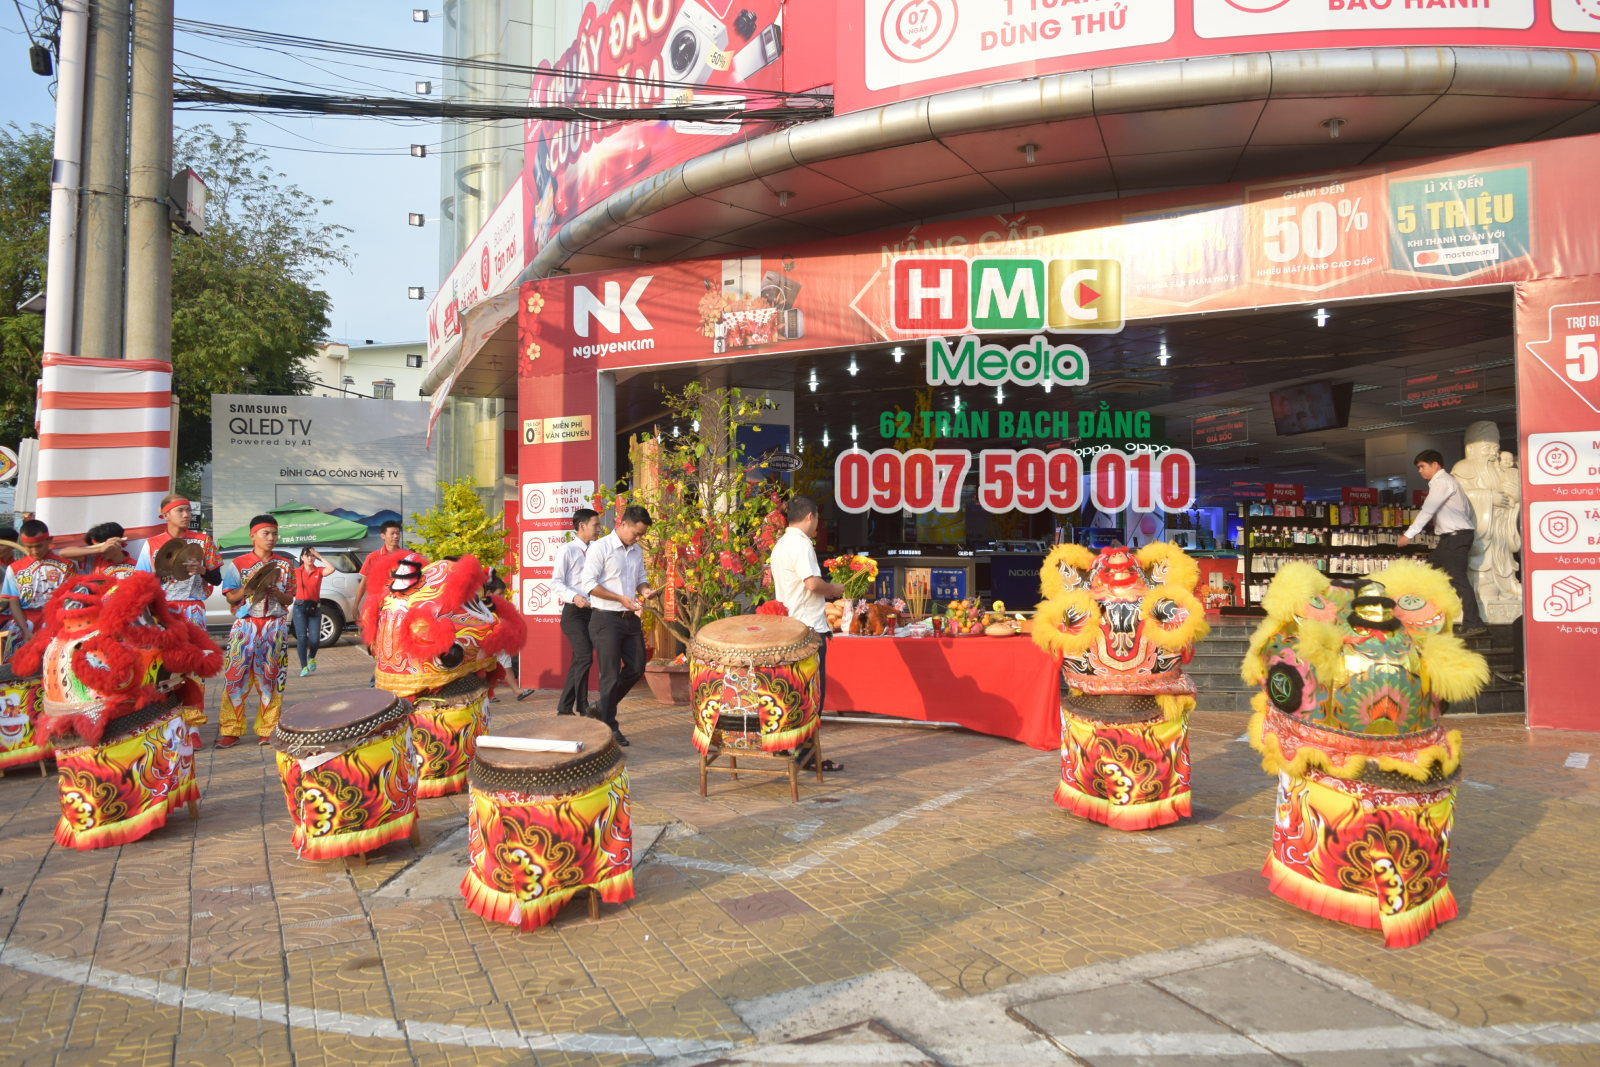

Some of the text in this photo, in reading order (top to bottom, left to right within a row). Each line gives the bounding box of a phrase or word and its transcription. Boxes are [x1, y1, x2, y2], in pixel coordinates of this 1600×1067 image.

[908, 9, 929, 25] 07
[908, 25, 929, 35] NGÀY
[981, 2, 1129, 51] DÙNG THỬ
[1424, 174, 1484, 194] LÌ XÌ ĐẾN
[1283, 181, 1345, 201] GIẢM ĐẾN
[1397, 191, 1514, 234] 5 TRIỆU
[1264, 197, 1369, 263] 50%
[1407, 229, 1505, 248] KHI THANH TOÁN VỚI
[1443, 247, 1495, 260] mastercard
[1257, 266, 1282, 277] NHIỀU
[1304, 259, 1329, 271] HÀNG
[1331, 260, 1352, 270] CAO
[573, 275, 655, 338] NK
[1566, 315, 1600, 331] TRỢ GI
[229, 403, 288, 414] SAMSUNG
[229, 417, 312, 436] QLED TV
[552, 419, 583, 430] MIỄN PHÍ
[526, 427, 541, 443] 0%
[546, 427, 590, 441] VẬN CHUYỂN
[230, 438, 312, 447] Powered by AI
[304, 468, 326, 478] CAO
[329, 467, 358, 478] CÔNG
[360, 467, 386, 480] NGHỆ
[388, 470, 399, 478] TV
[552, 485, 582, 496] MIỄN PHÍ
[1571, 487, 1594, 496] dụng
[560, 494, 579, 504] TUẦN
[549, 504, 570, 514] DÙNG
[1573, 556, 1596, 565] dụng
[1008, 569, 1040, 577] NOKIA
[1575, 625, 1598, 635] dụng
